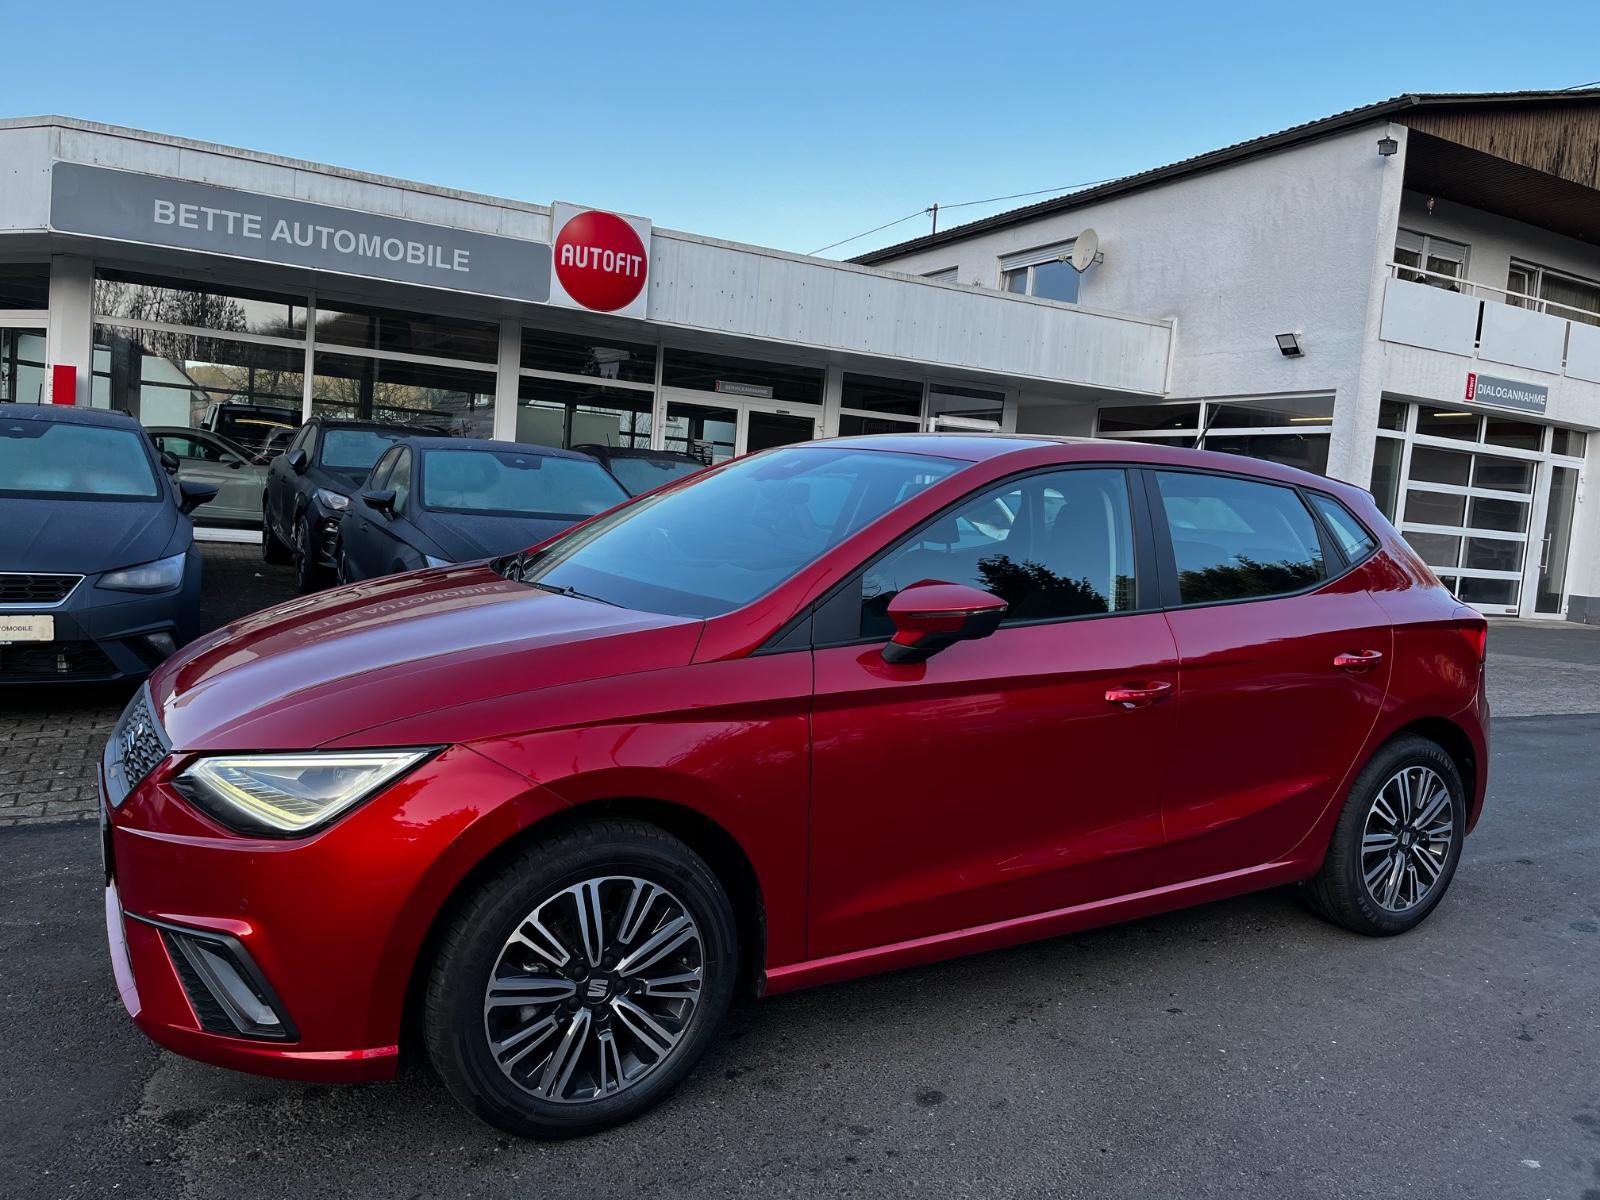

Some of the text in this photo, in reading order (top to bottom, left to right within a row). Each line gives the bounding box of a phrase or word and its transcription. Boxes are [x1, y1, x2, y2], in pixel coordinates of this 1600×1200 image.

[153, 199, 470, 272] BETTE AUTOMOBILE
[561, 243, 642, 277] AUTOFIT
[1477, 383, 1546, 405] DIALOGANNAHME
